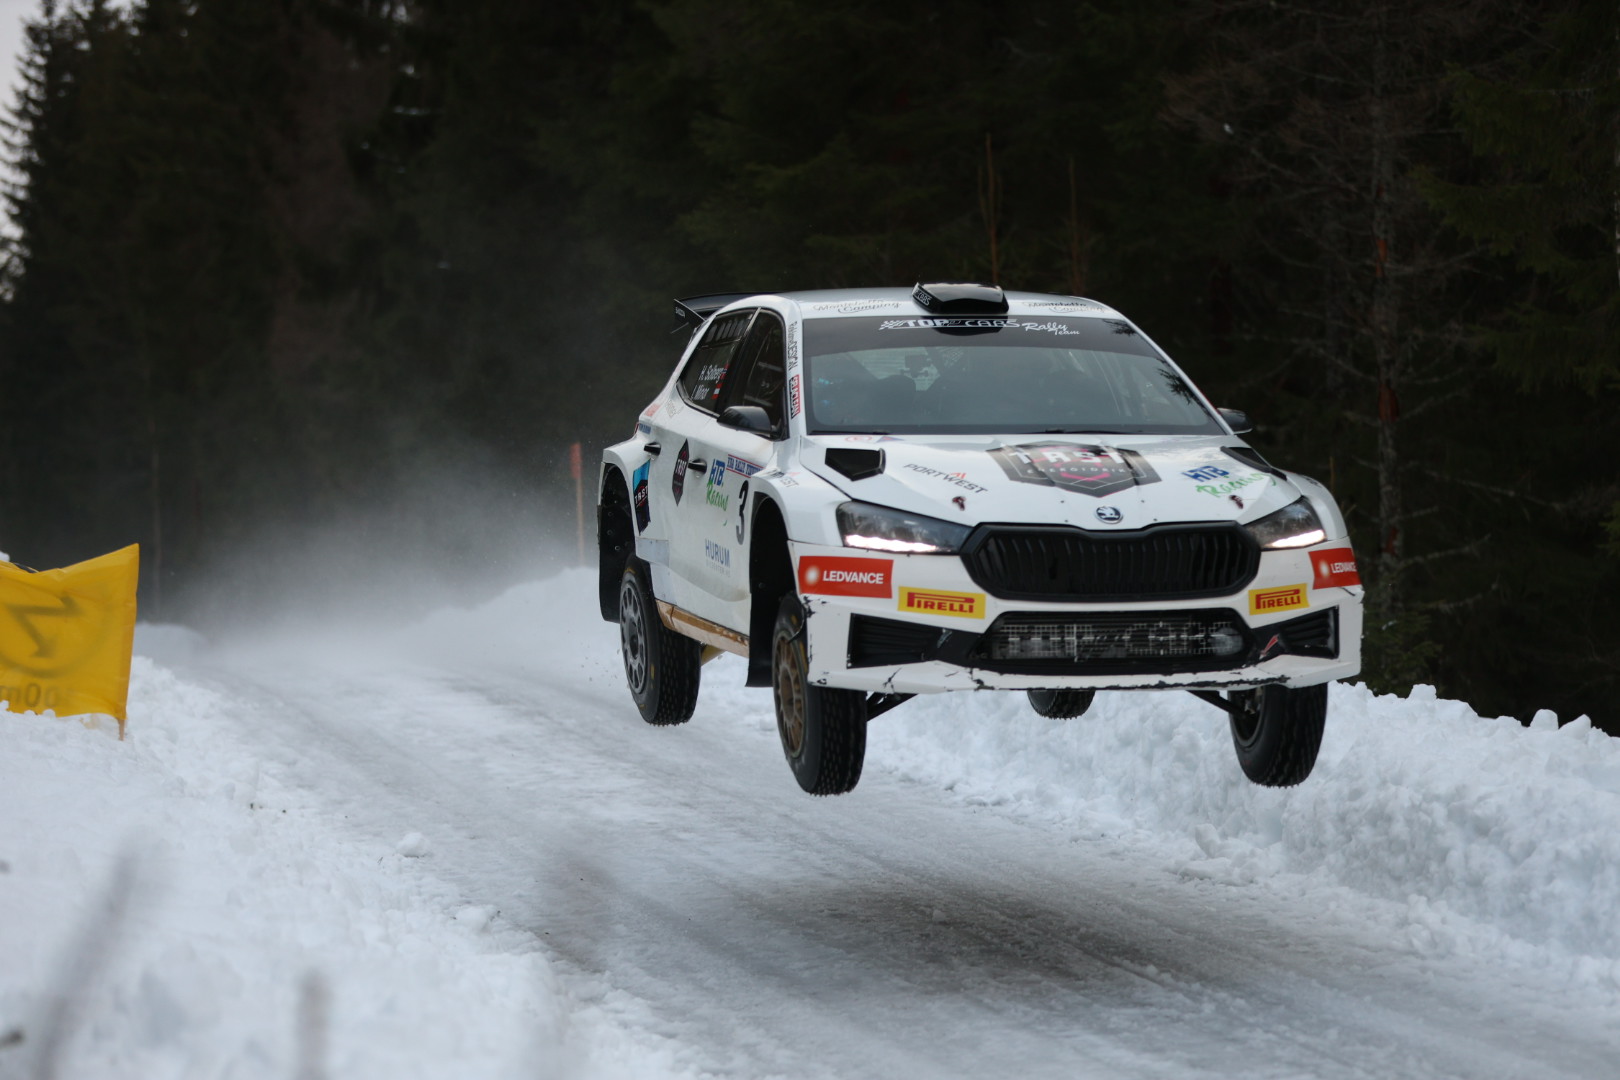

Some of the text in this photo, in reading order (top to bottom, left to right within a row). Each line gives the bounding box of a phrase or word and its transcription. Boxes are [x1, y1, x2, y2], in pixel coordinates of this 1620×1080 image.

[904, 318, 1068, 332] TOP CARS Rally
[903, 463, 989, 494] PORTWEST
[1181, 465, 1230, 482] HTB
[736, 480, 749, 545] 3
[705, 539, 731, 568] HURUM
[823, 570, 884, 585] LEDVANCE
[906, 591, 976, 614] PIRELLI
[1255, 588, 1302, 610] PIRELLI
